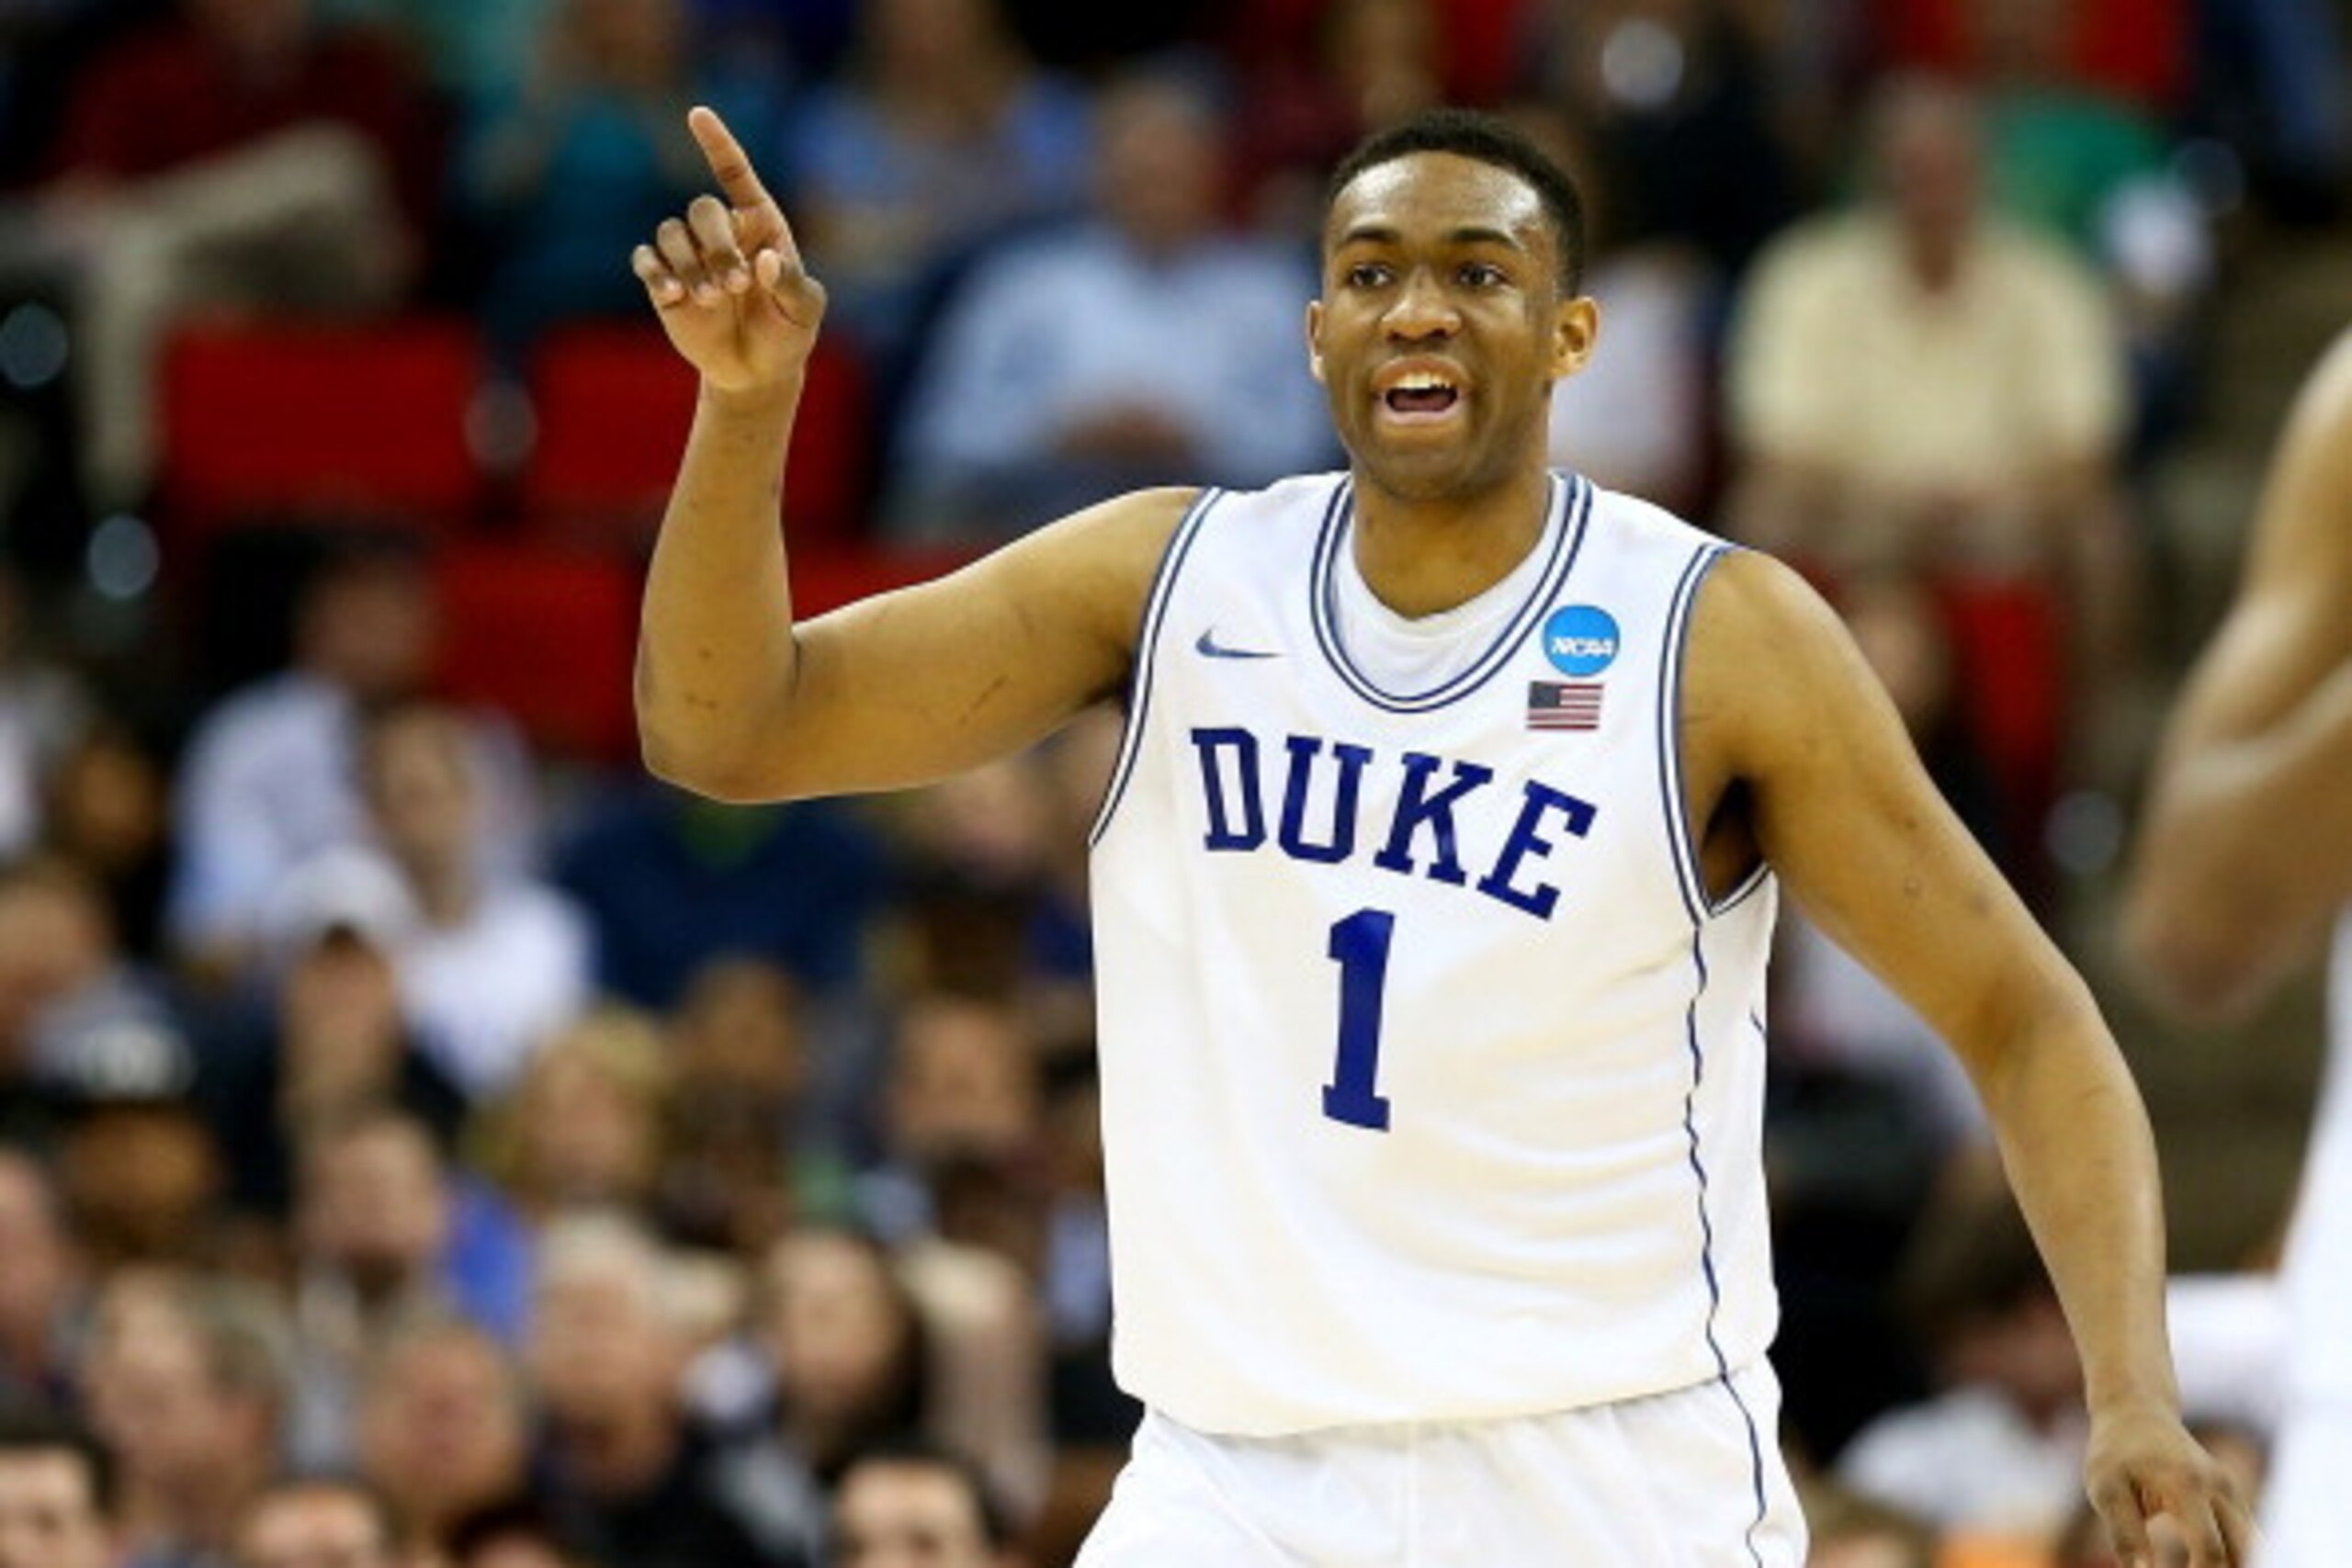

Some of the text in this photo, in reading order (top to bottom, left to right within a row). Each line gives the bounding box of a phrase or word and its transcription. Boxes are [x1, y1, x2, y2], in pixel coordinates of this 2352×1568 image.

[1551, 637, 1613, 657] NCAA
[1190, 727, 1599, 921] DUKE
[1321, 908, 1396, 1132] 1
